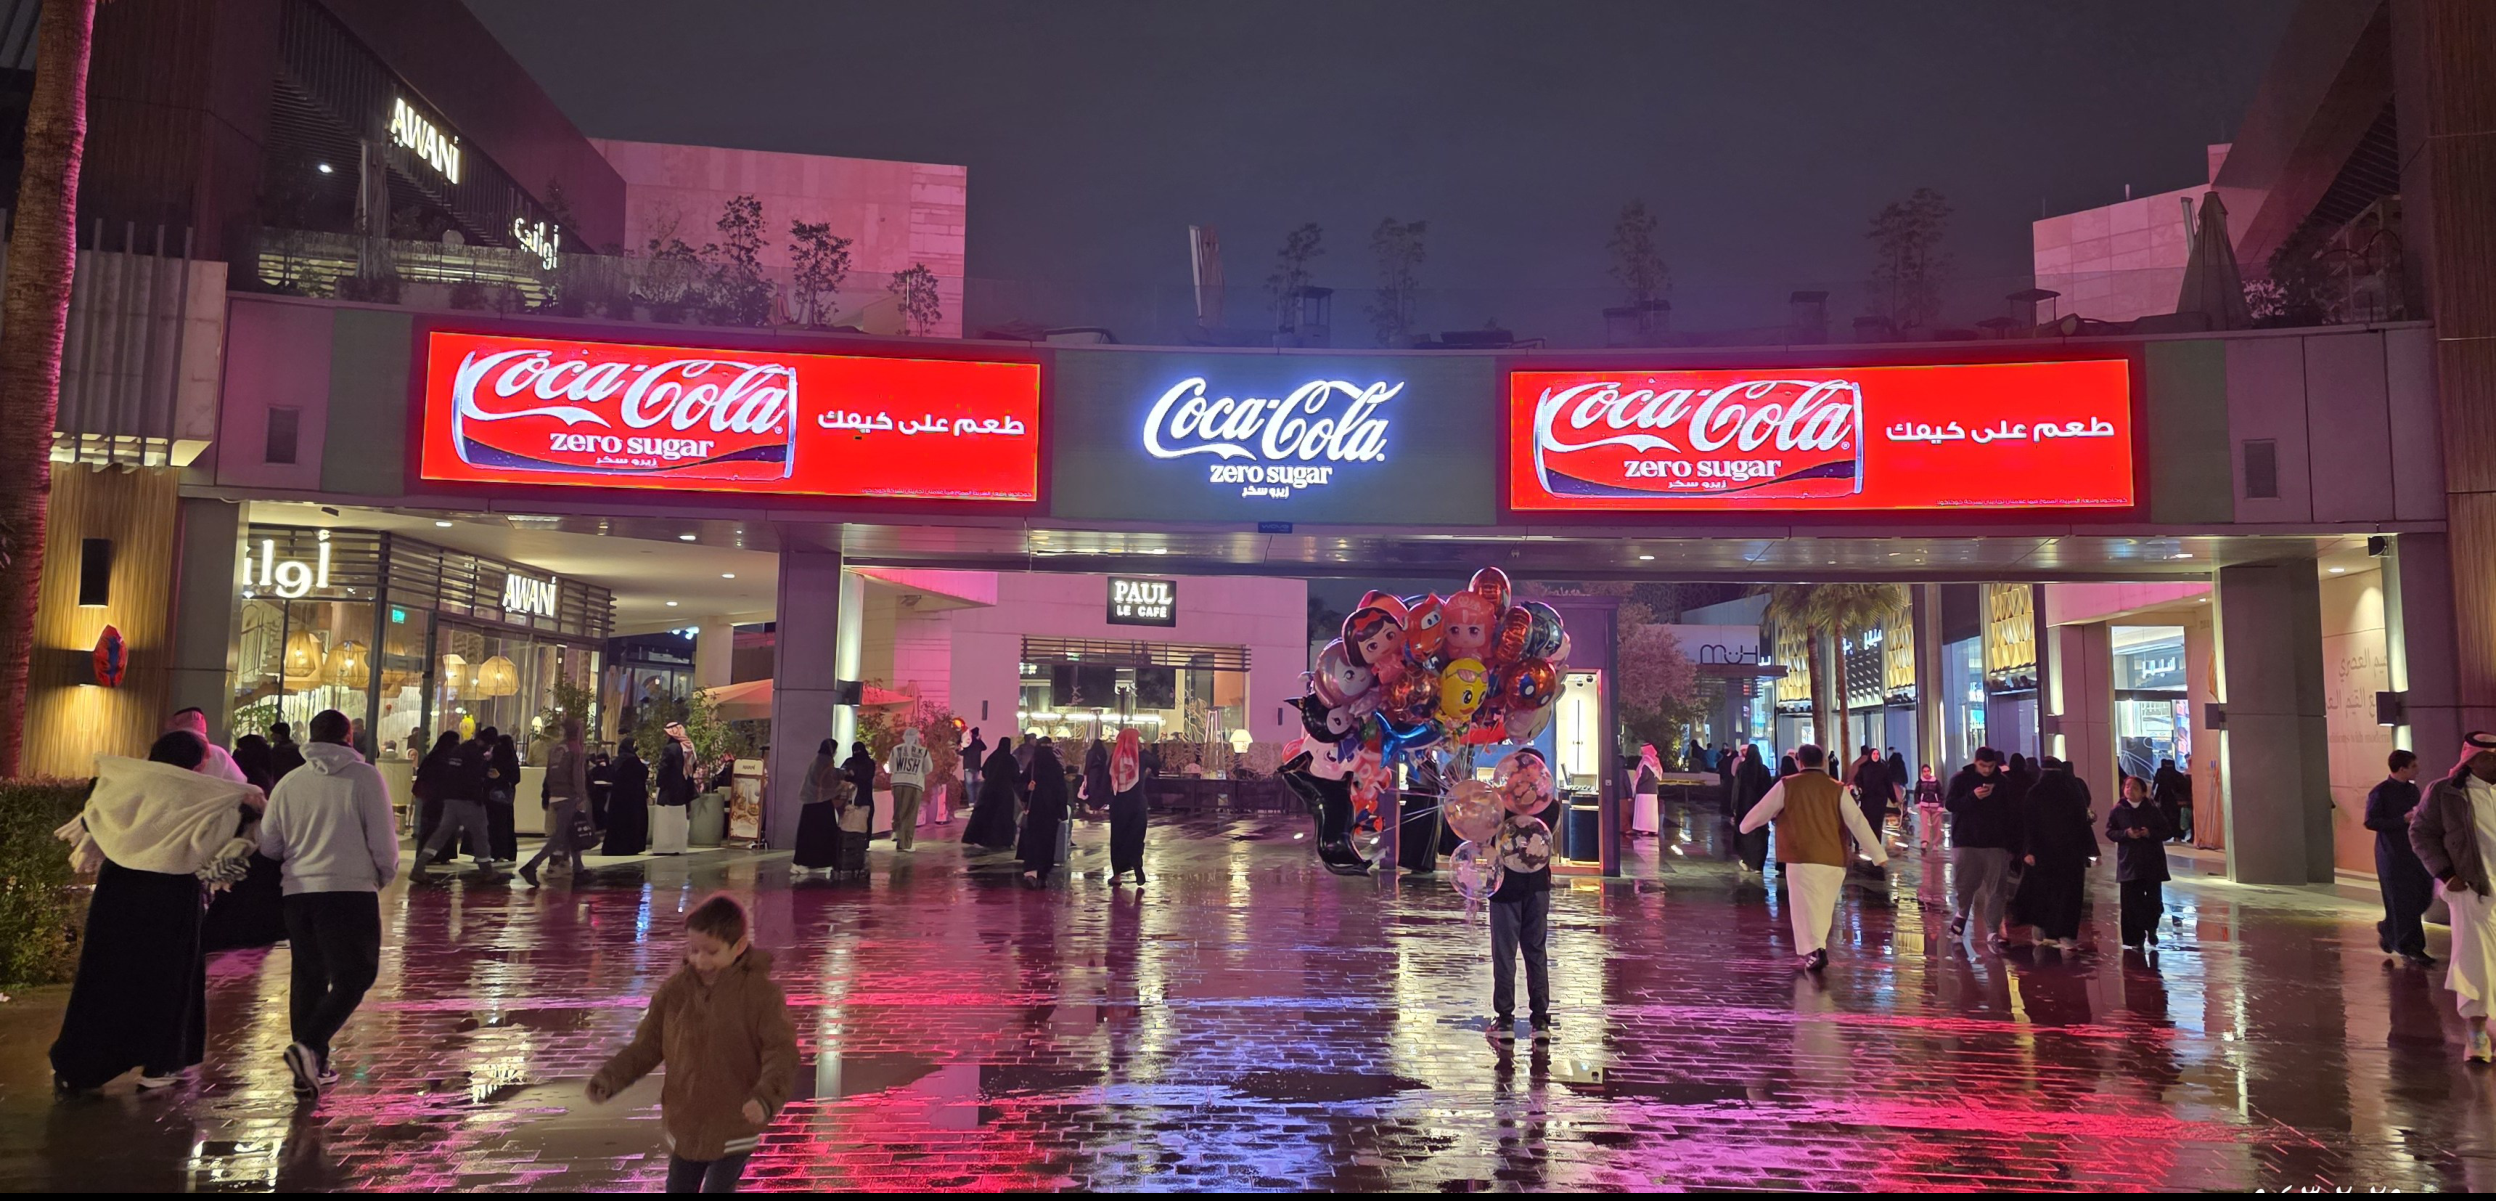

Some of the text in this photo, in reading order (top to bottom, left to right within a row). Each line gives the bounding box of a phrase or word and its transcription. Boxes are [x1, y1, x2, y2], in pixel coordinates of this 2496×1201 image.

[390, 97, 460, 184] AWANI
[461, 349, 789, 434] Coca-Cola
[898, 413, 949, 436] على
[954, 415, 1025, 437] طعم
[1143, 377, 1404, 462] Coca-Cola
[1542, 379, 1854, 453] Coca-Cola
[1971, 420, 2028, 444] على
[2033, 416, 2115, 442] طعم
[549, 432, 714, 459] zero sugar
[1210, 465, 1333, 489] zero sugar
[1624, 460, 1781, 481] zero sugar
[1242, 485, 1290, 499] زيرو سكر
[502, 573, 557, 618] AWANI
[1114, 580, 1173, 605] PAUL
[1116, 605, 1131, 616] LE
[896, 757, 921, 773] WISH
